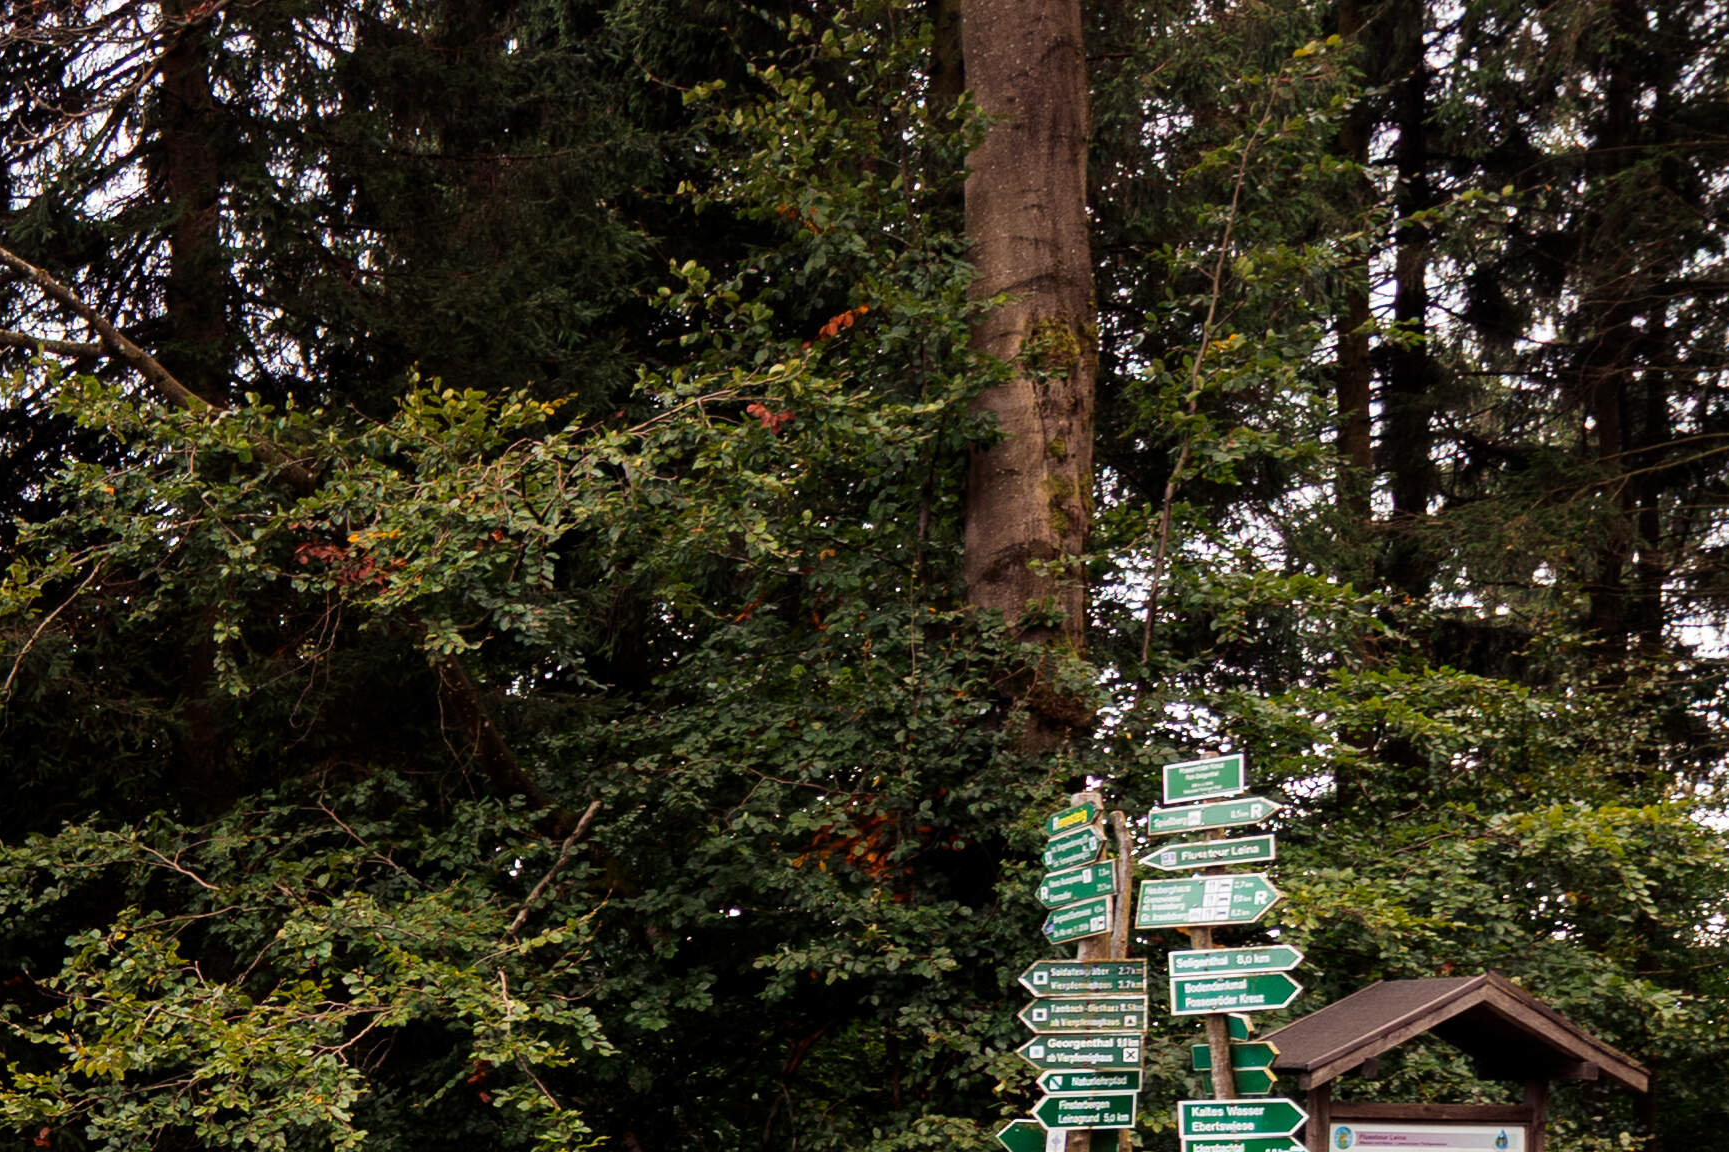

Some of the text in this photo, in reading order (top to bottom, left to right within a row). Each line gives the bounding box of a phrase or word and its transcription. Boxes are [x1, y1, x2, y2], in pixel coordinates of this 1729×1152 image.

[1181, 845, 1260, 861] Flusstour Leina
[1047, 1038, 1113, 1050] Georgenthal
[1191, 1105, 1265, 1118] Kaltes Wasser
[1191, 1121, 1255, 1132] Ebertswiese
